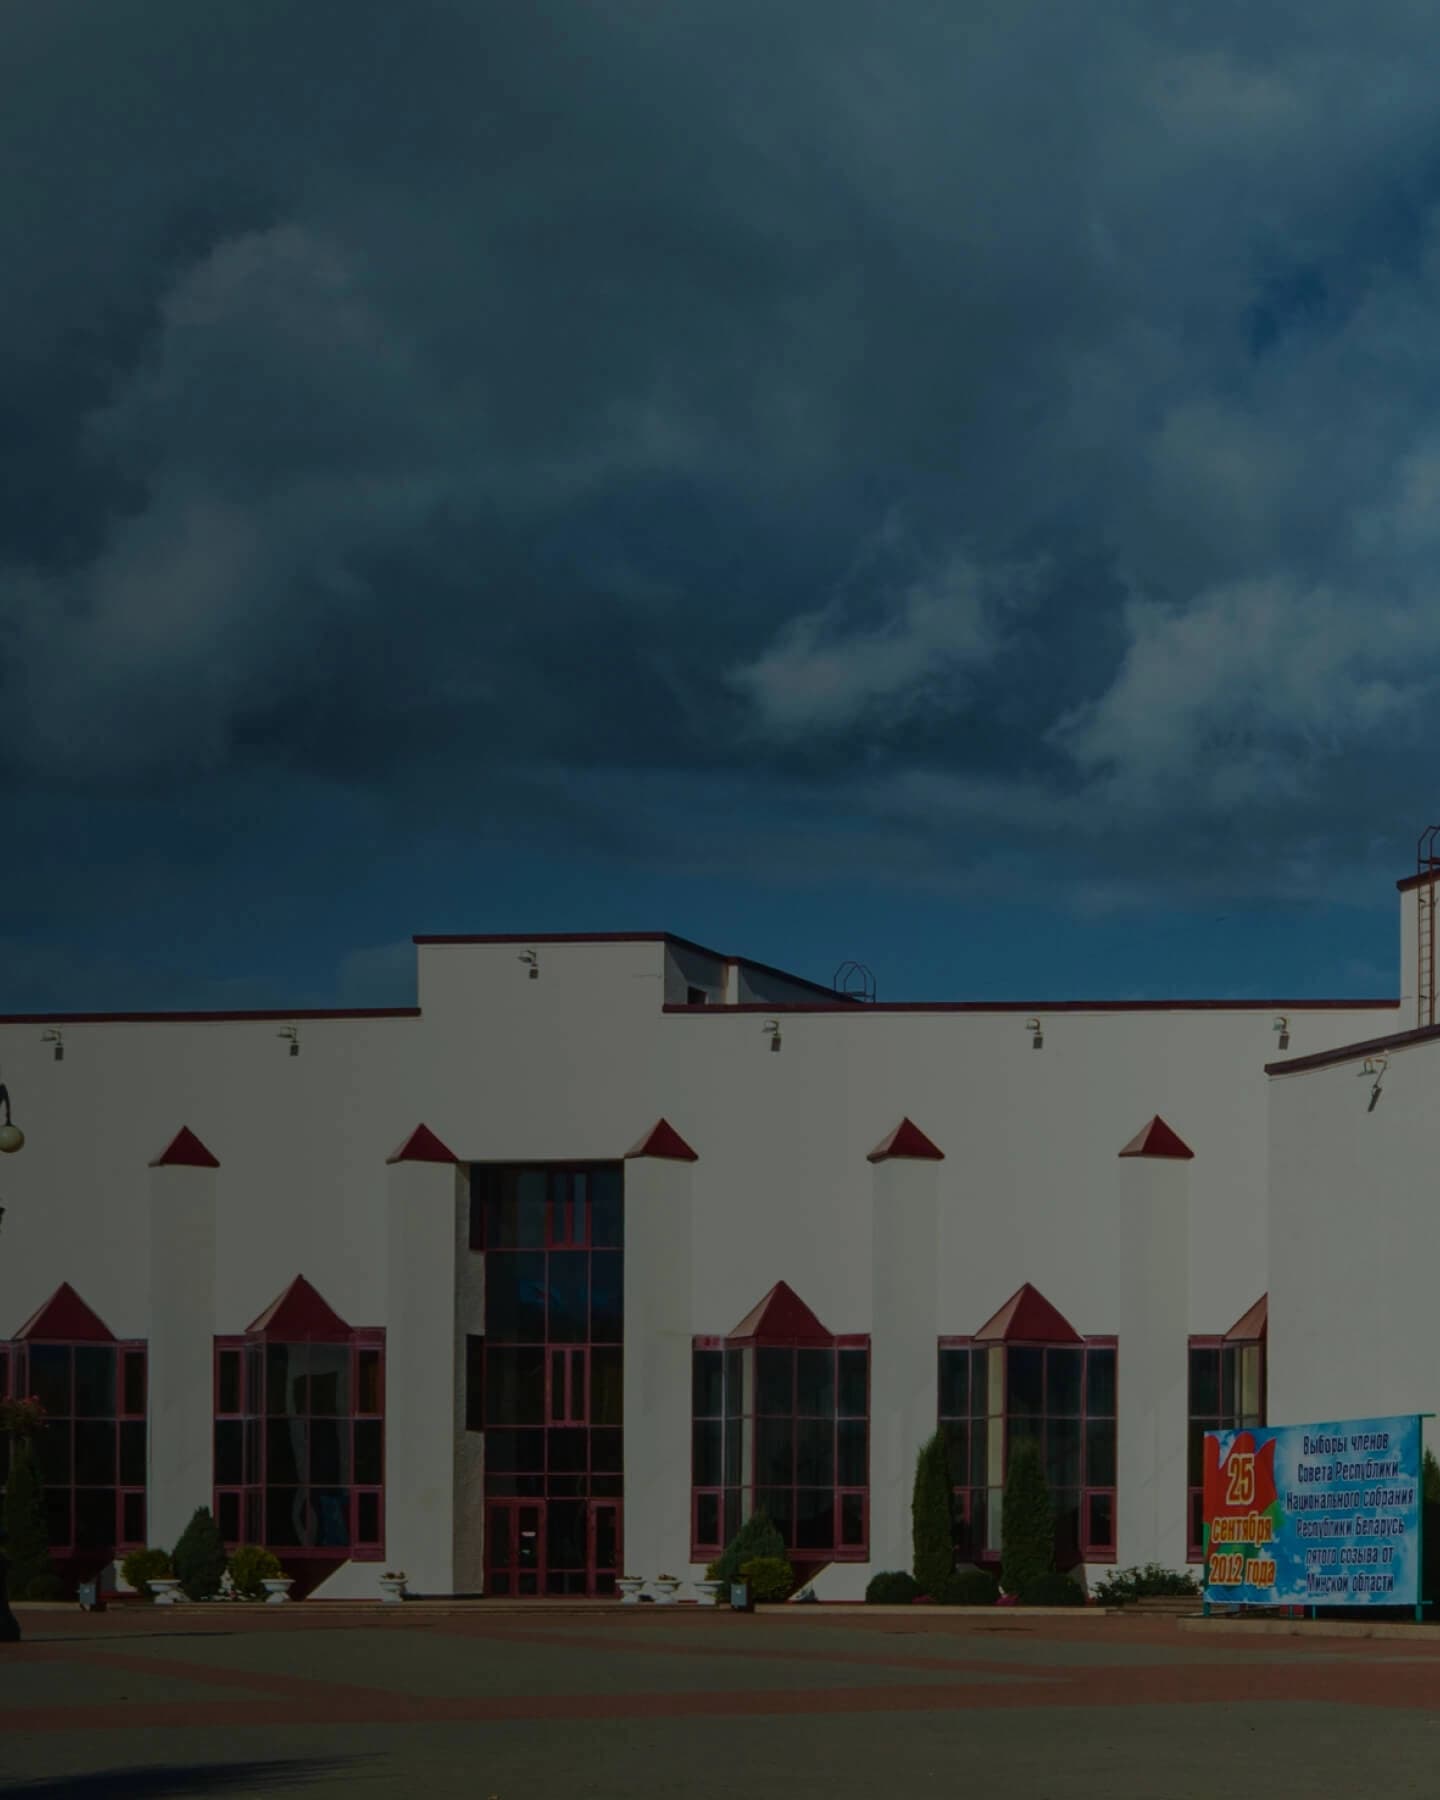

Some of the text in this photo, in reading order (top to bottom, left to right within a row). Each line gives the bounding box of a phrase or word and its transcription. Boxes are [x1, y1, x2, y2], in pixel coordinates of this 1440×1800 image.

[1304, 1433, 1389, 1455] Выборы членов
[1226, 1453, 1255, 1505] 25
[1298, 1459, 1399, 1482] Совета Республики
[1287, 1486, 1413, 1511] Национального собрания
[1211, 1511, 1272, 1547] сентября
[1297, 1516, 1404, 1539] Республики Беларусь
[1306, 1547, 1393, 1566] пятого созыва от
[1209, 1554, 1276, 1588] 2012 года
[1306, 1573, 1394, 1593] Минской области
